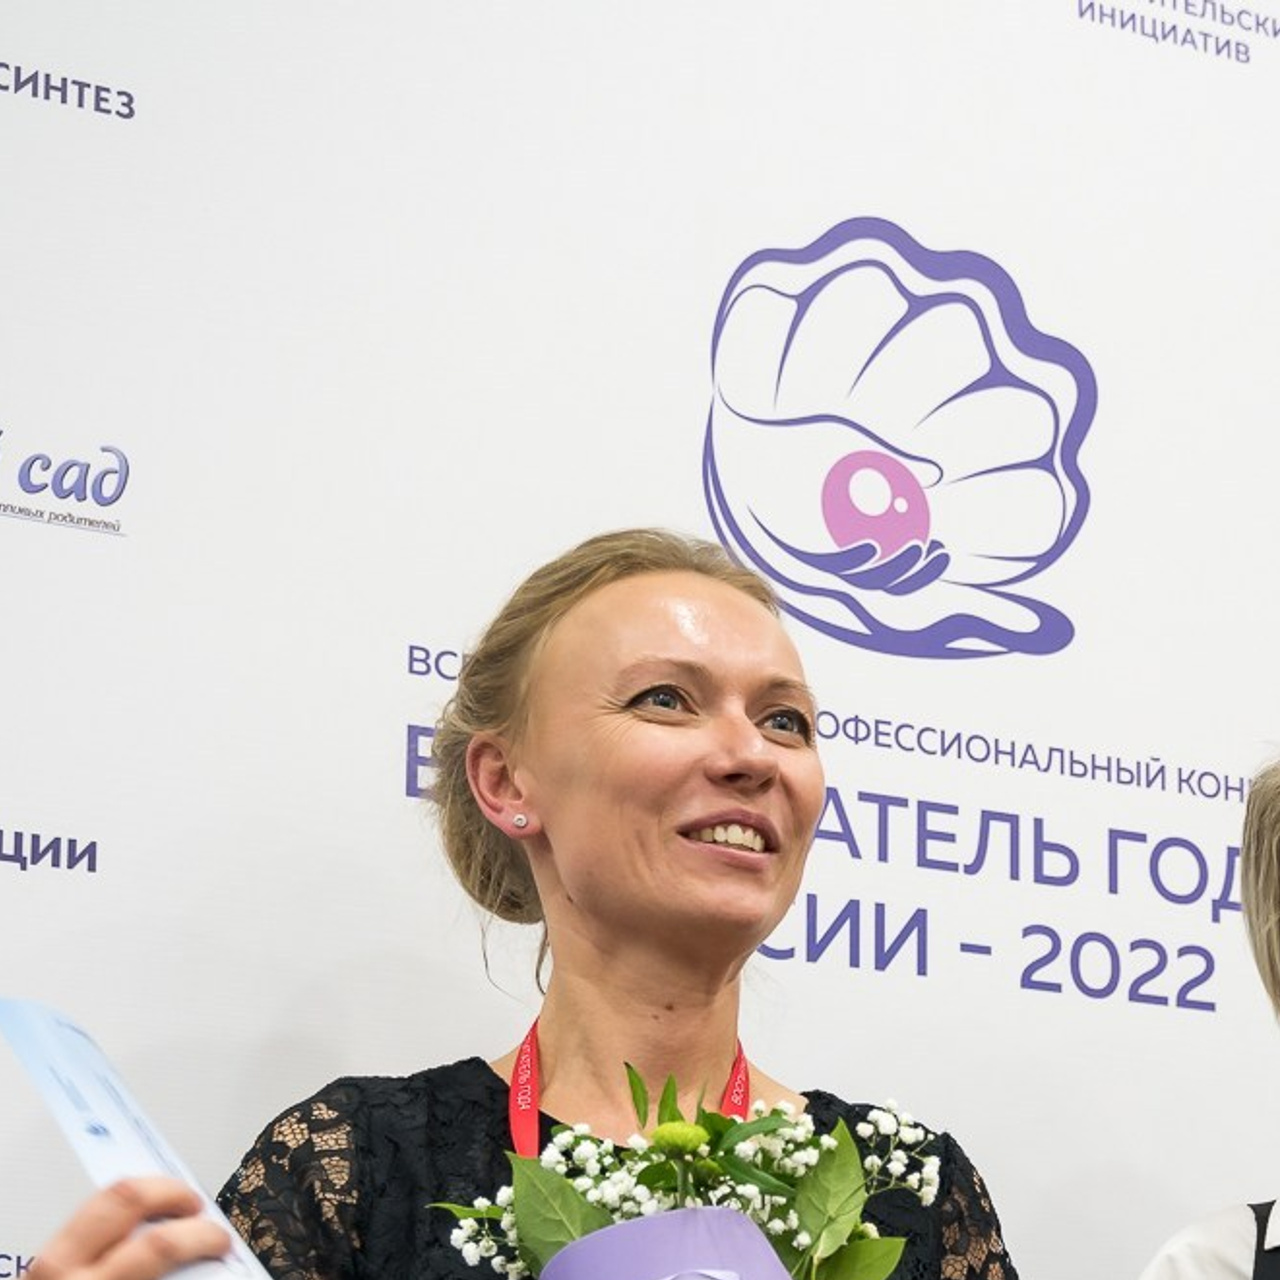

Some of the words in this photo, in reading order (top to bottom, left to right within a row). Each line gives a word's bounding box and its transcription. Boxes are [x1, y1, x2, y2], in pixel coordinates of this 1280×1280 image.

[1077, 0, 1251, 63] ИНИЦИАТИВ
[18, 446, 130, 507] сад
[816, 710, 1167, 792] ОФЕССИОНАЛЬНЫЙ
[1019, 923, 1216, 1013] 2022
